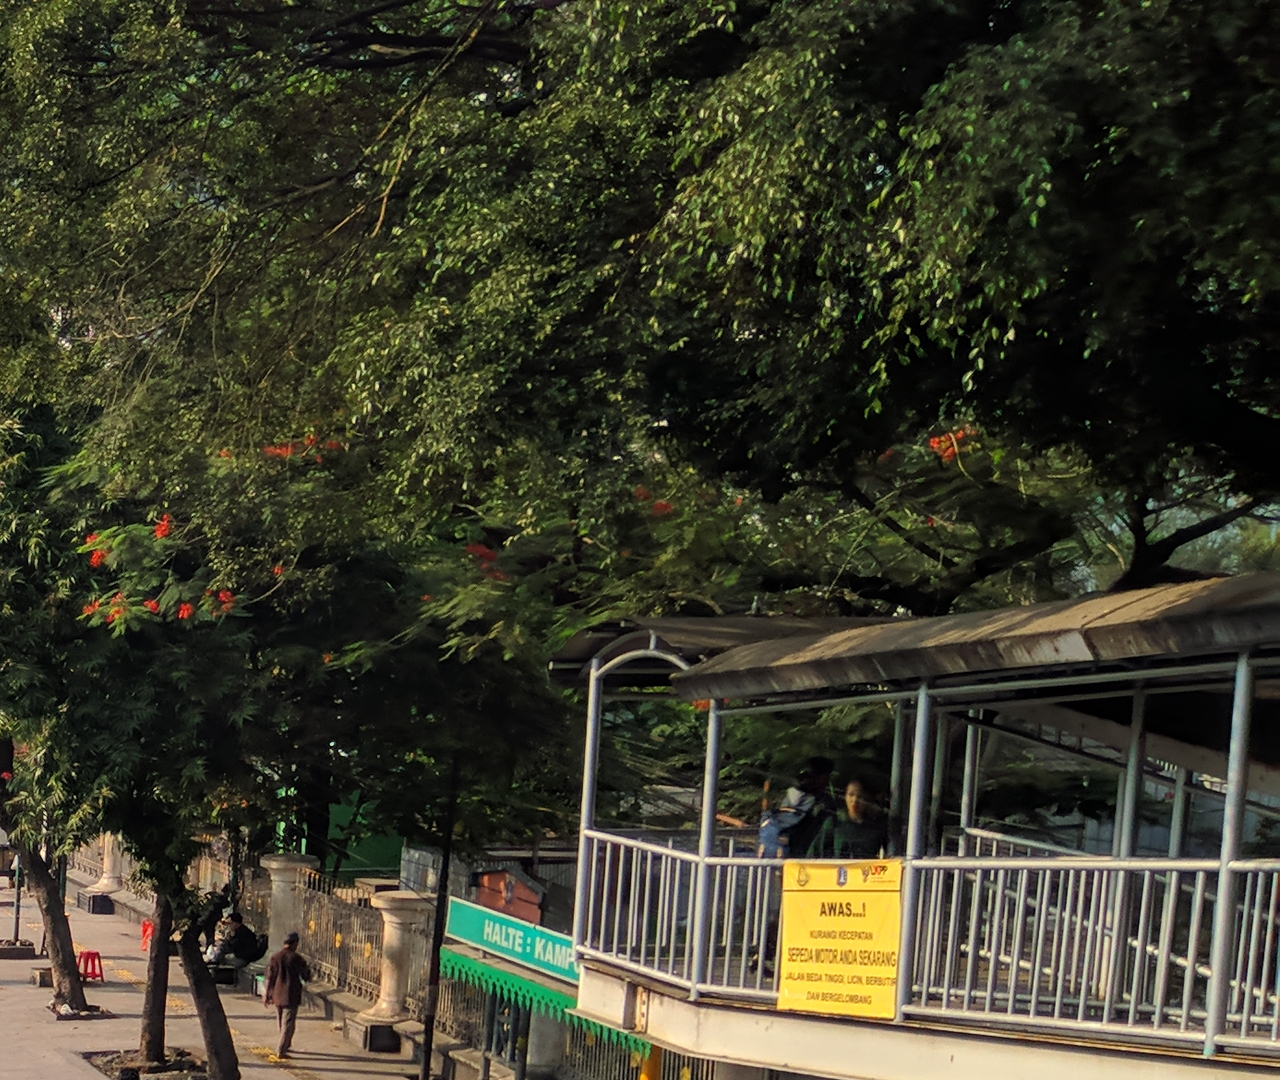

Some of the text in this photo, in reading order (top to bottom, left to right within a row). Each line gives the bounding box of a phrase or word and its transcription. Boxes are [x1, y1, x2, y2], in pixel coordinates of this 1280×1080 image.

[483, 919, 524, 953] HALTE
[839, 931, 873, 940] KECEPATAN
[788, 947, 896, 967] SEPEDA MOTOR ANDA SEKARANG
